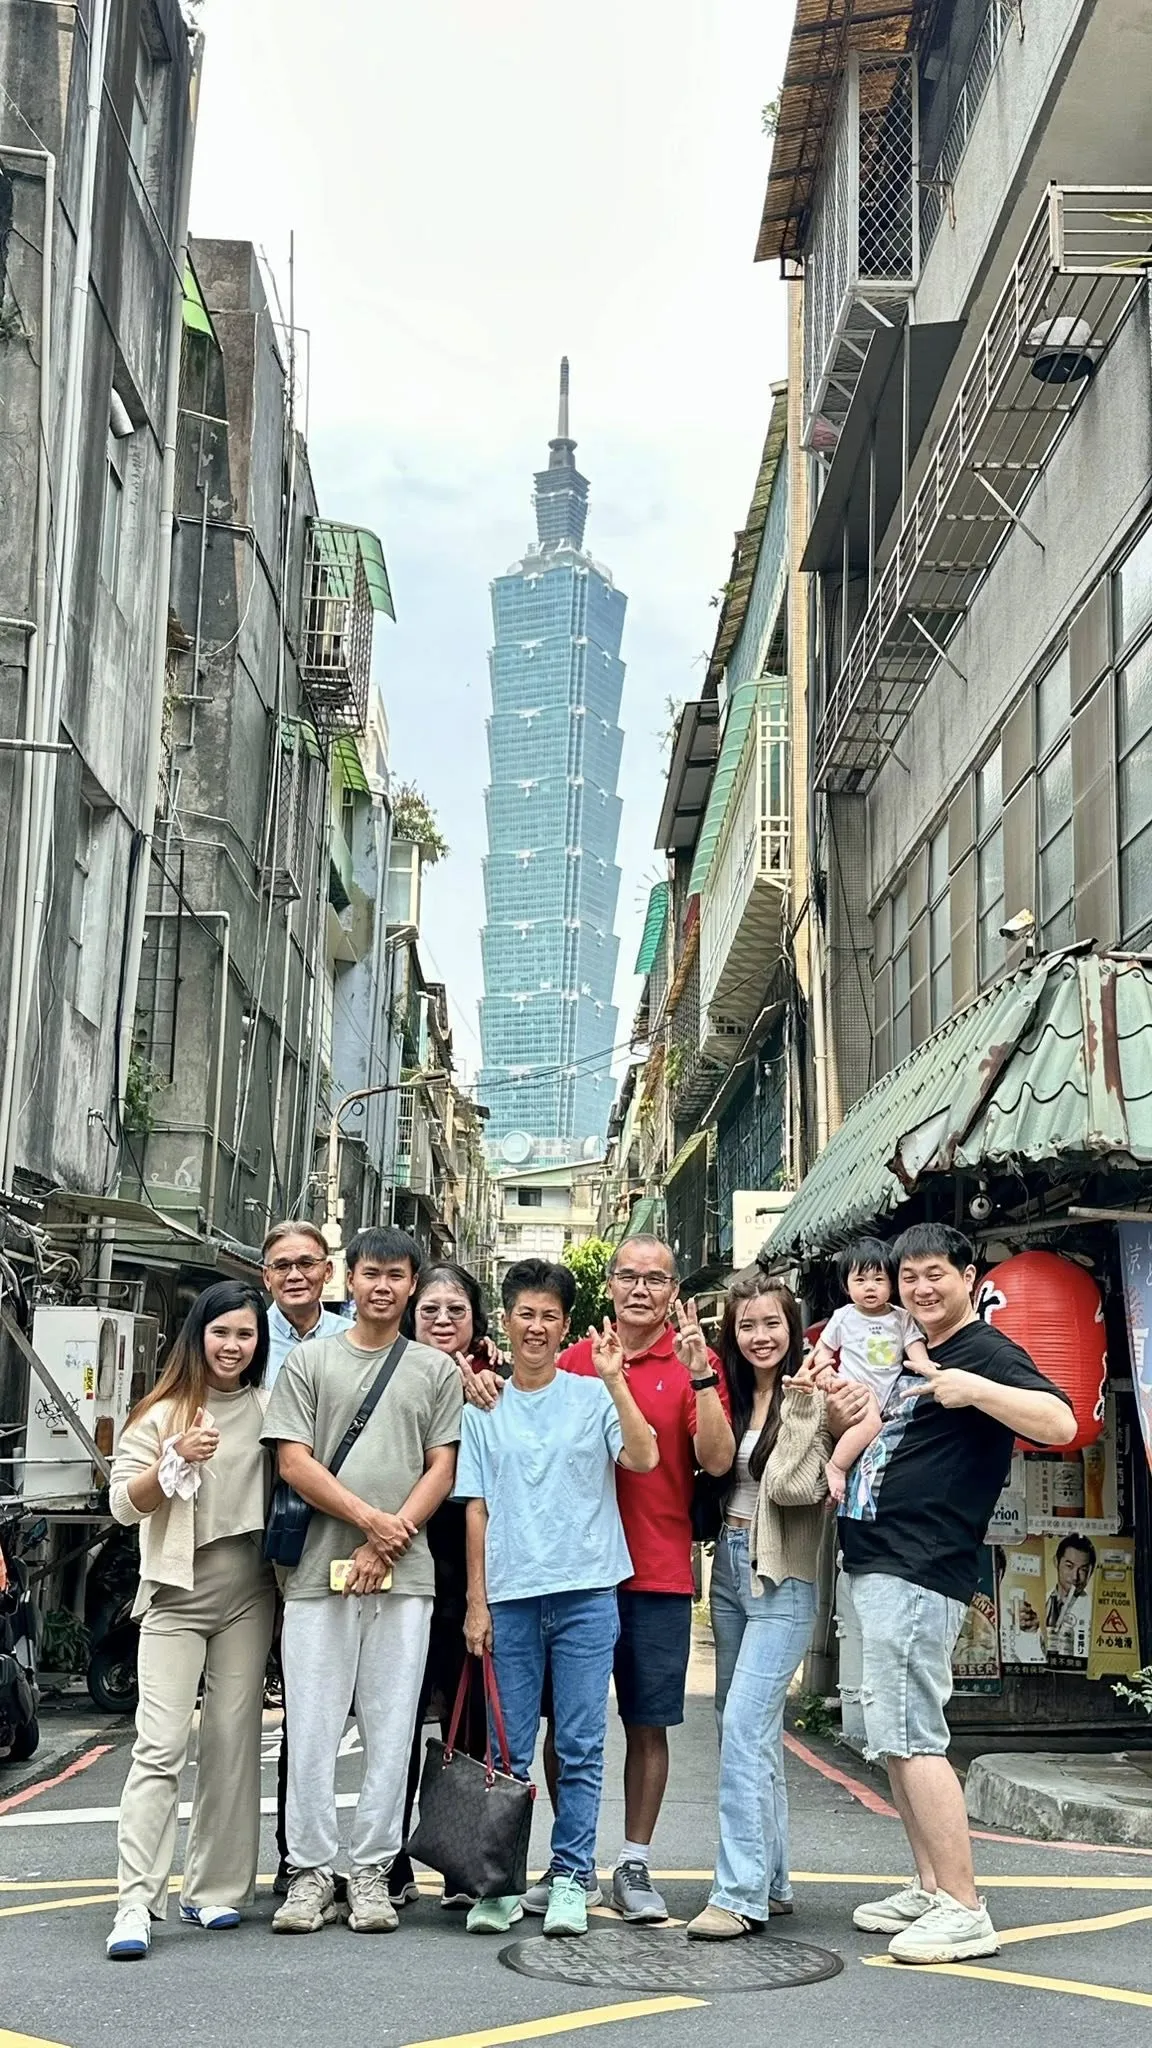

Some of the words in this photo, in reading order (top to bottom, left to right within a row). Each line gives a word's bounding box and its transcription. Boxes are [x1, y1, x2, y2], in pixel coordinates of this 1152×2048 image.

[995, 1506, 1019, 1521] rion
[1102, 1590, 1127, 1598] CAUTION
[1111, 1598, 1131, 1607] FLOOR
[1096, 1635, 1133, 1649] 小心地滑
[959, 1664, 993, 1675] BEER
